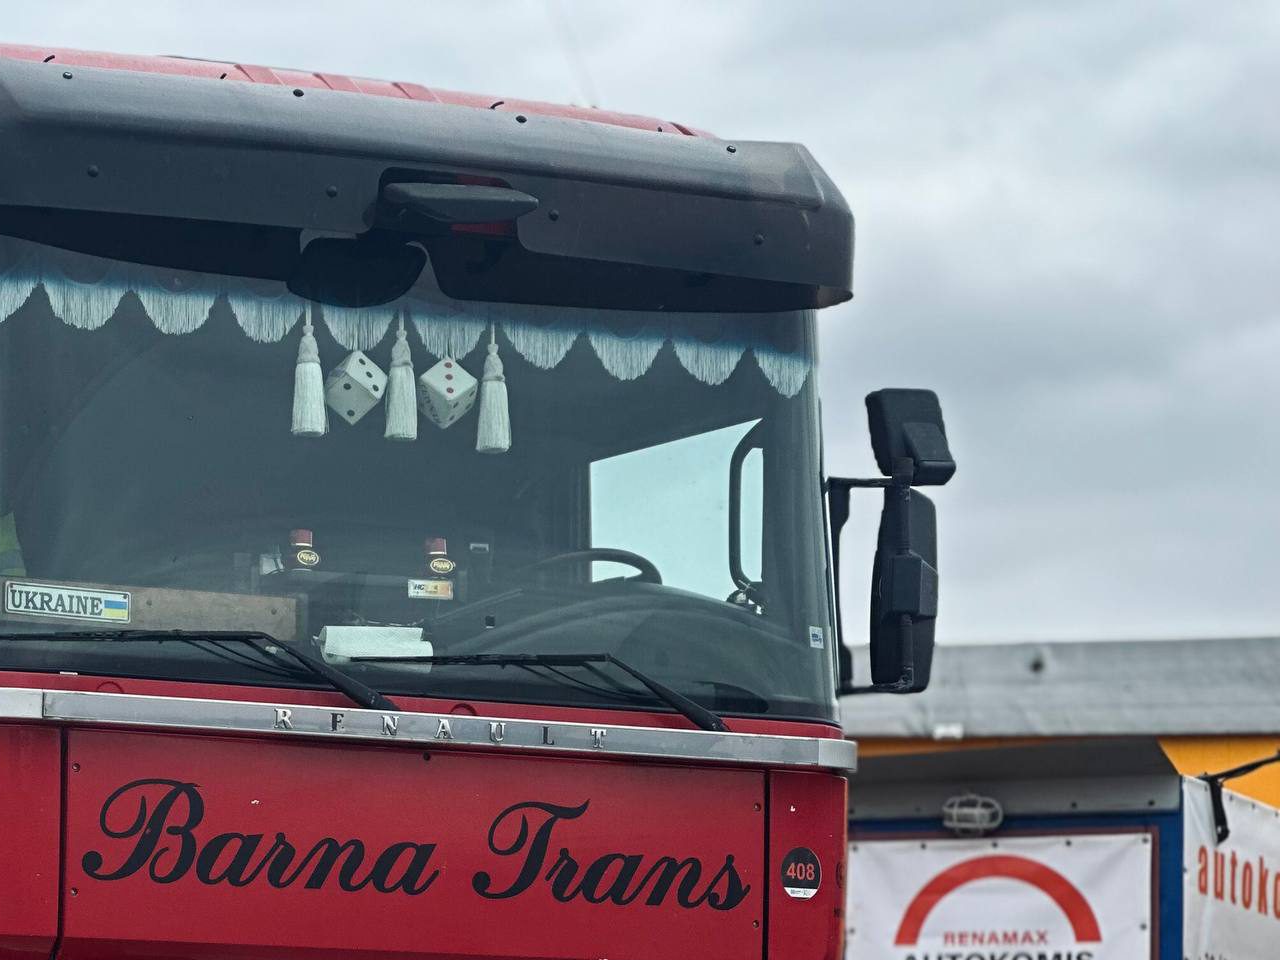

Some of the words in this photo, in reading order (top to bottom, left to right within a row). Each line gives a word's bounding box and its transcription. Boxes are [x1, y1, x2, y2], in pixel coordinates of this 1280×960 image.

[9, 589, 104, 617] UKRAINE
[273, 707, 608, 749] RENAULT
[81, 778, 438, 896] Barna
[471, 798, 751, 911] Trans
[786, 862, 816, 881] 408
[943, 930, 1049, 946] RENAMAX
